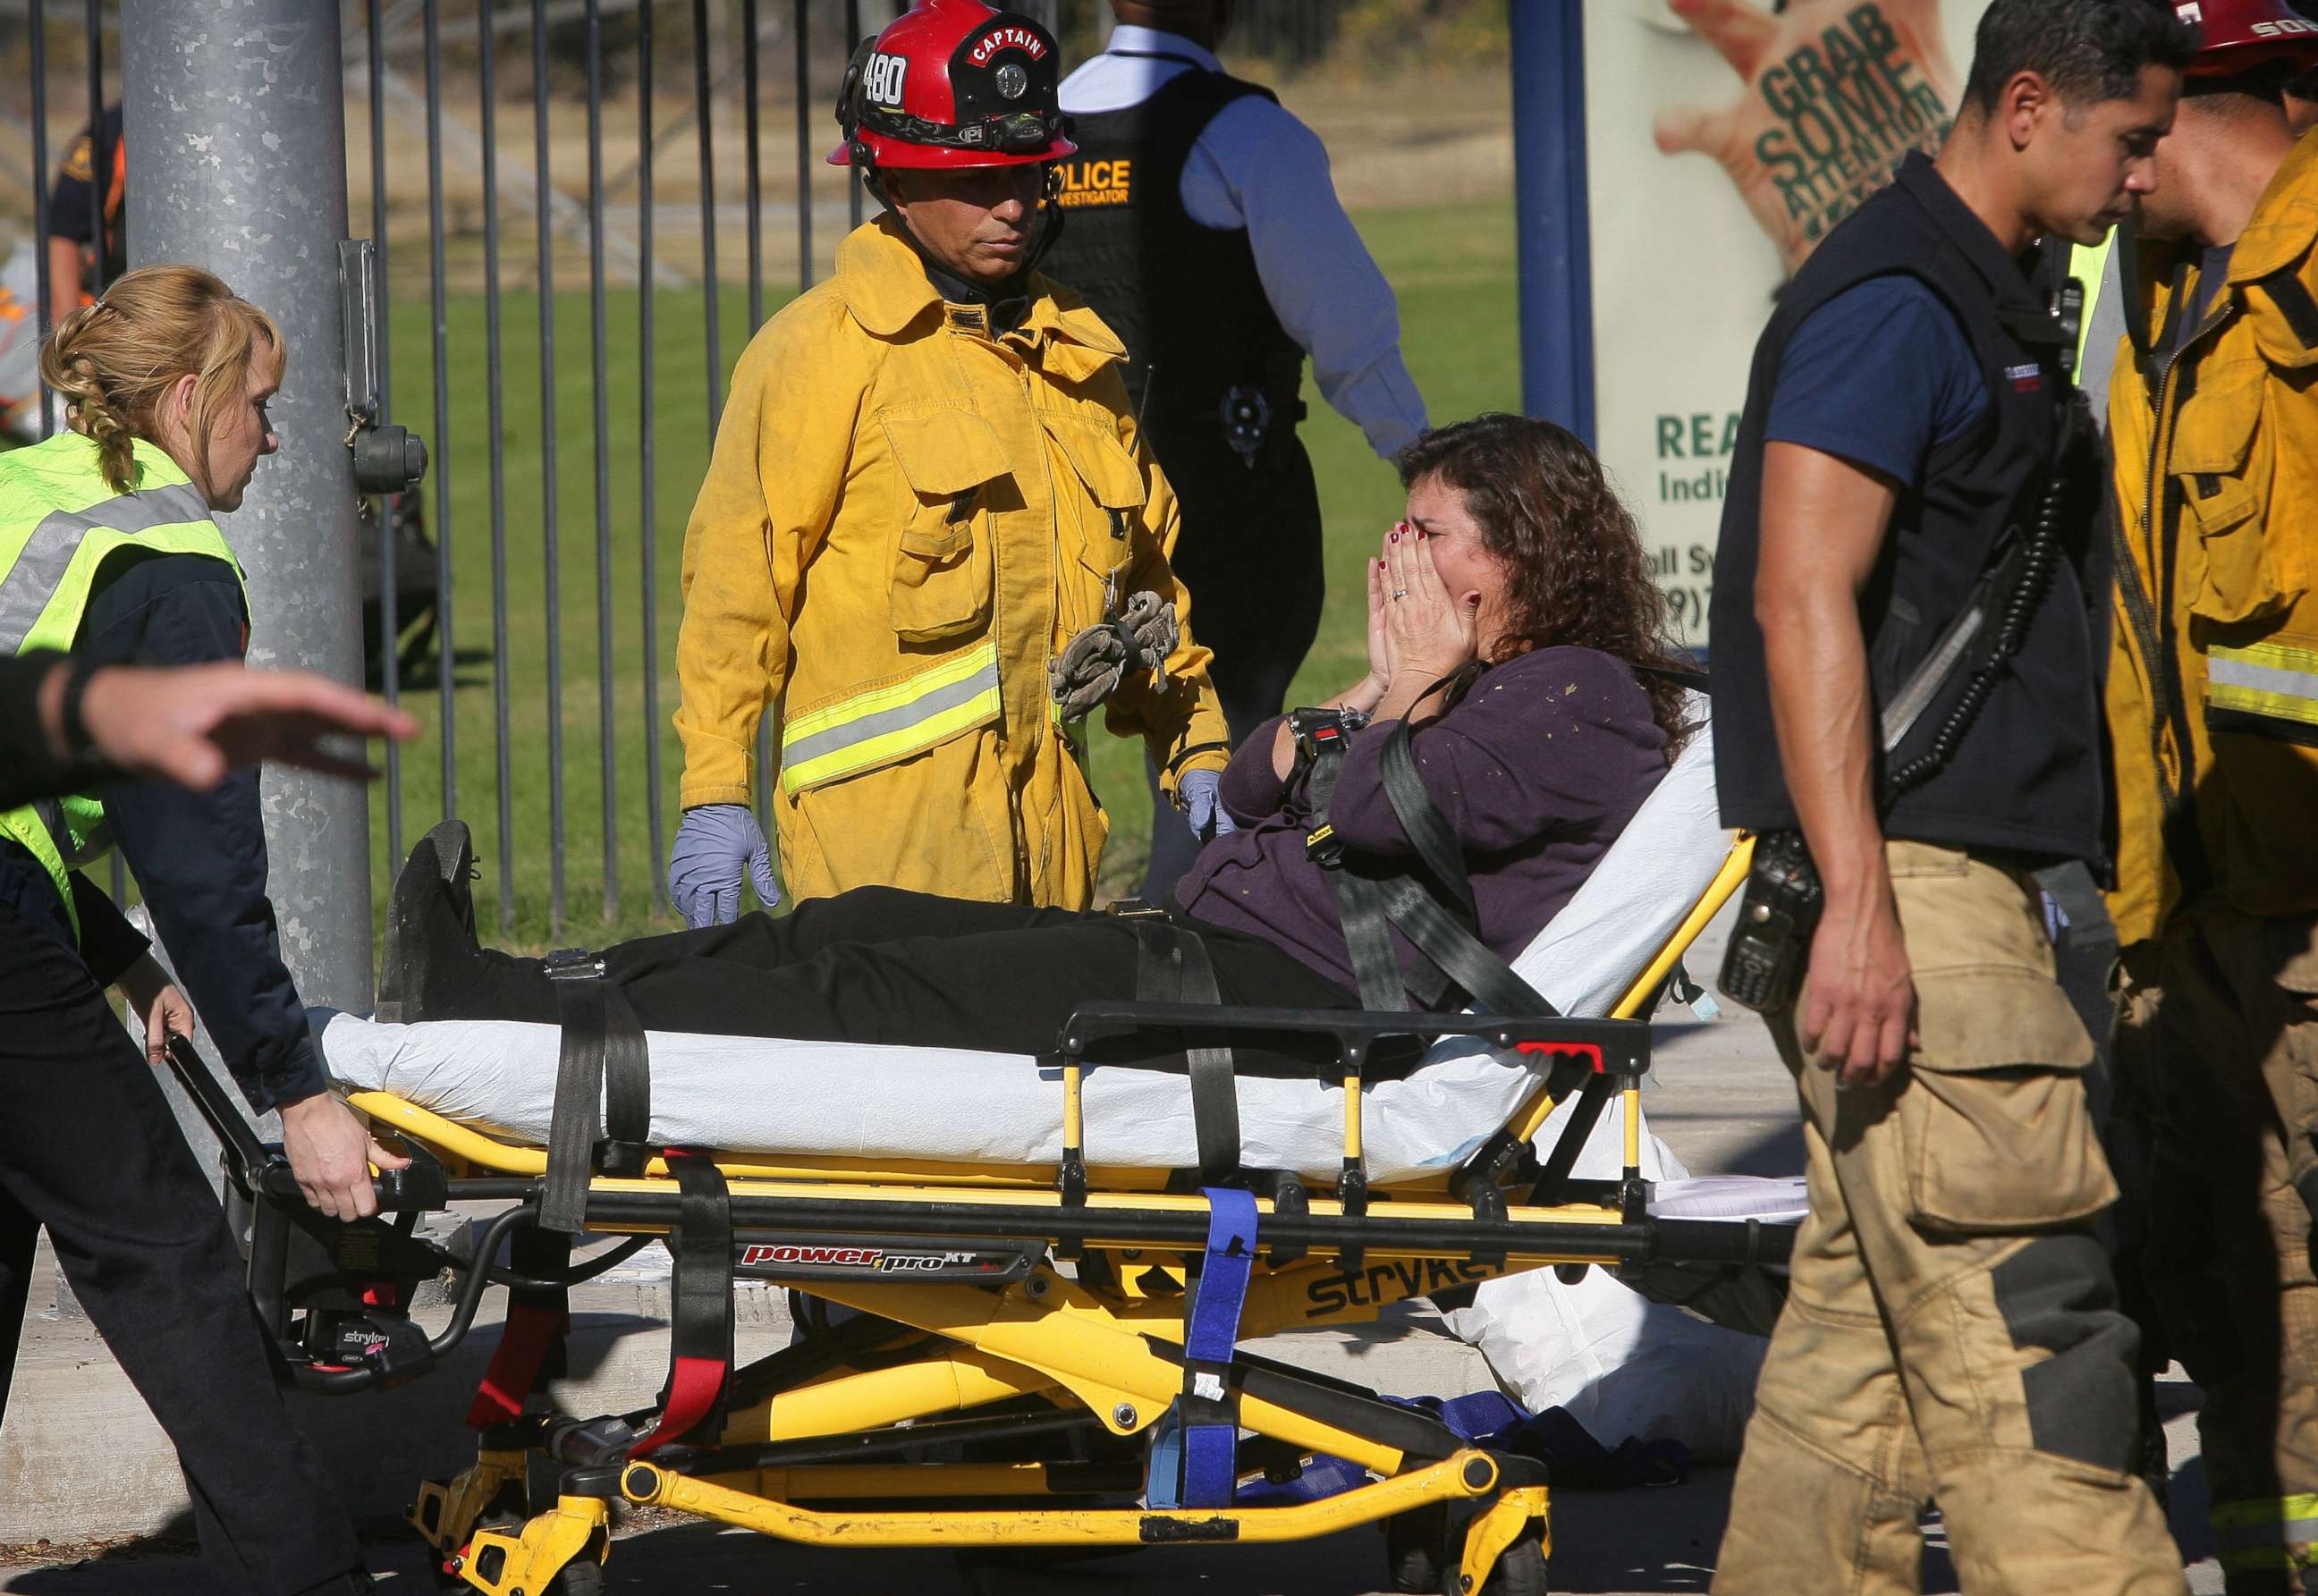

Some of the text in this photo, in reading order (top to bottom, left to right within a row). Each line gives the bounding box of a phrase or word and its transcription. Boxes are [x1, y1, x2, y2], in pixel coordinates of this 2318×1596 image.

[973, 29, 1041, 61] CAPTAIN
[1760, 3, 1899, 120] GRAB
[863, 52, 907, 105] 480
[1755, 52, 1914, 182] SOME
[1774, 80, 1947, 221] ATTENTION
[1053, 161, 1131, 191] LICE
[741, 1245, 977, 1273] power pro XT
[343, 1330, 386, 1345] stryke
